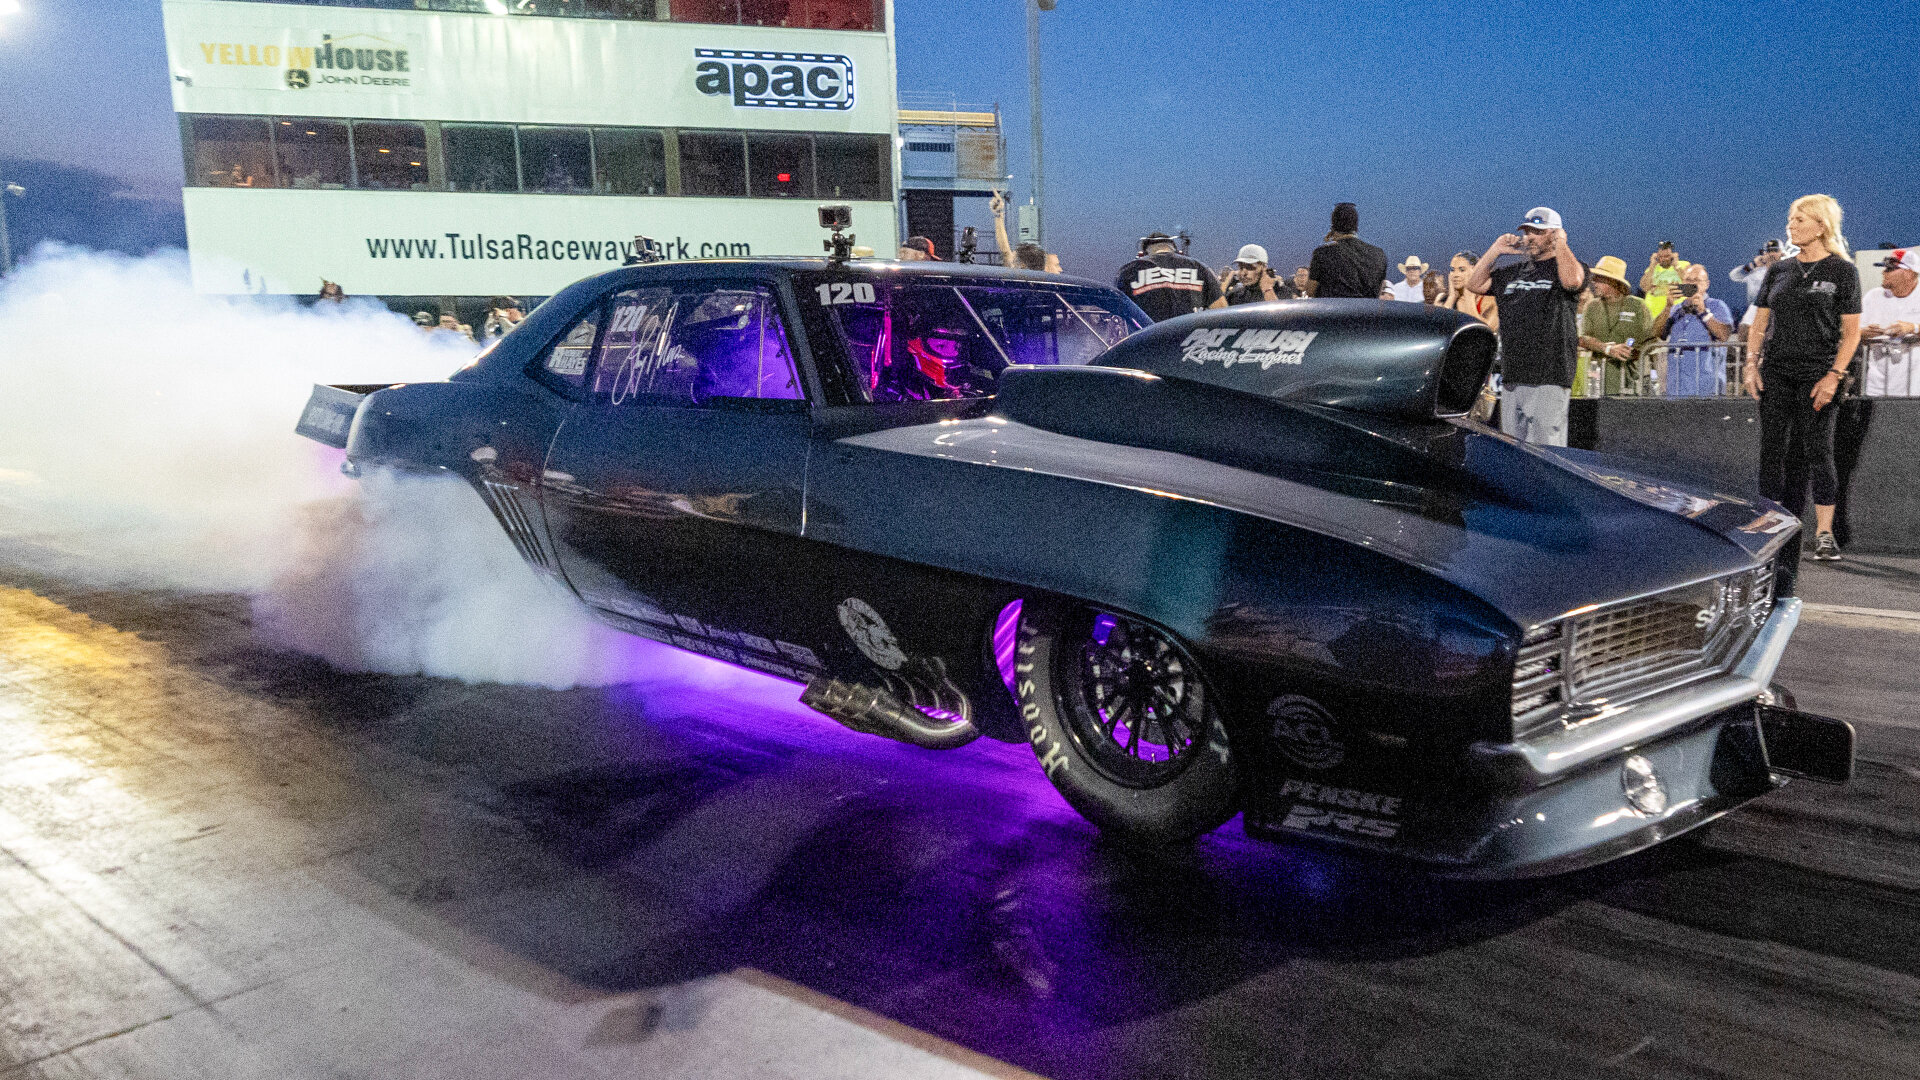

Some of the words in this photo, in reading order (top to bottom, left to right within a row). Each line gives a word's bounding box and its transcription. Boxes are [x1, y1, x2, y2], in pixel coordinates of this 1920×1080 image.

[316, 74, 358, 85] JOHN
[360, 75, 411, 87] DEERE
[695, 61, 840, 106] apac
[366, 232, 751, 263] www.TulsaRacewayark.com
[1130, 266, 1204, 289] JESEL
[814, 282, 876, 305] 120
[610, 305, 648, 332] 120
[1180, 328, 1240, 347] PAT
[1182, 345, 1240, 368] Racing
[1237, 348, 1305, 370] Engines
[1278, 779, 1402, 816] PENSKE
